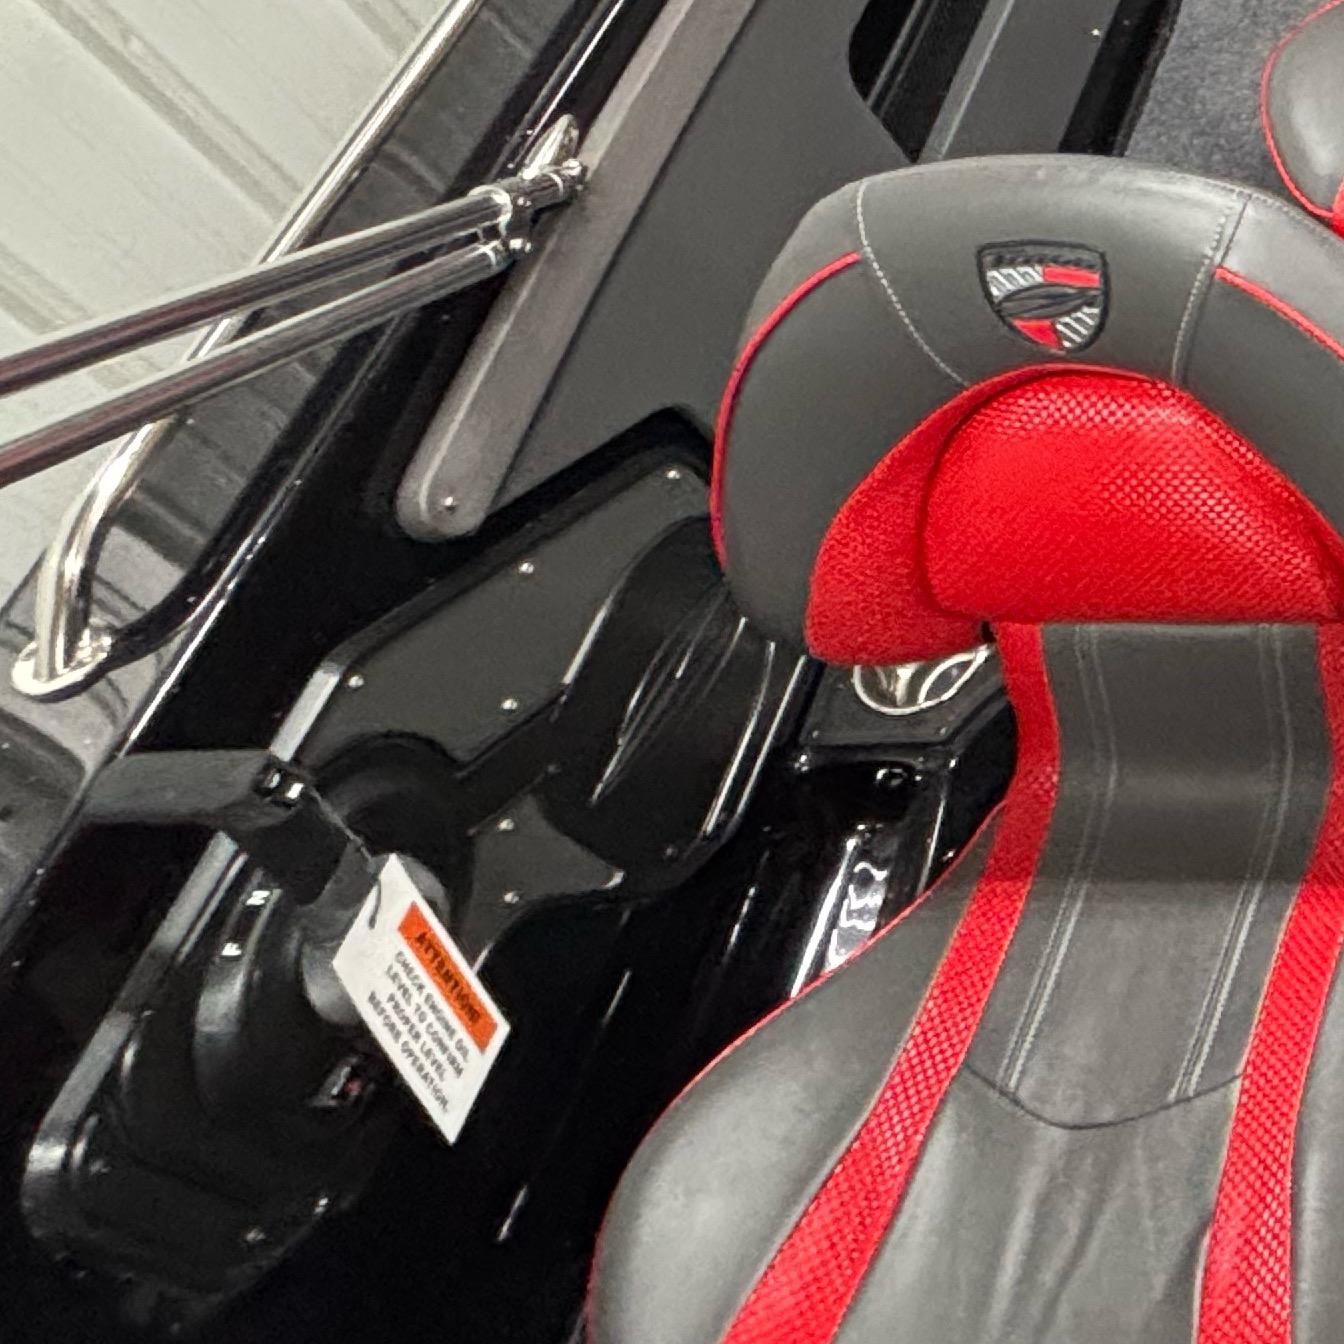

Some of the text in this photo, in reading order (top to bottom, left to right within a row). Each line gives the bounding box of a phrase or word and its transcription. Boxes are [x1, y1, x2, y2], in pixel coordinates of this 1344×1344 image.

[368, 990, 401, 1044] BEFORE
[386, 964, 464, 1079] LEVEL TO CONFIRM
[386, 992, 447, 1082] PROPER LEVEL
[395, 950, 425, 993] CHECK
[424, 992, 456, 1038] ENGINE
